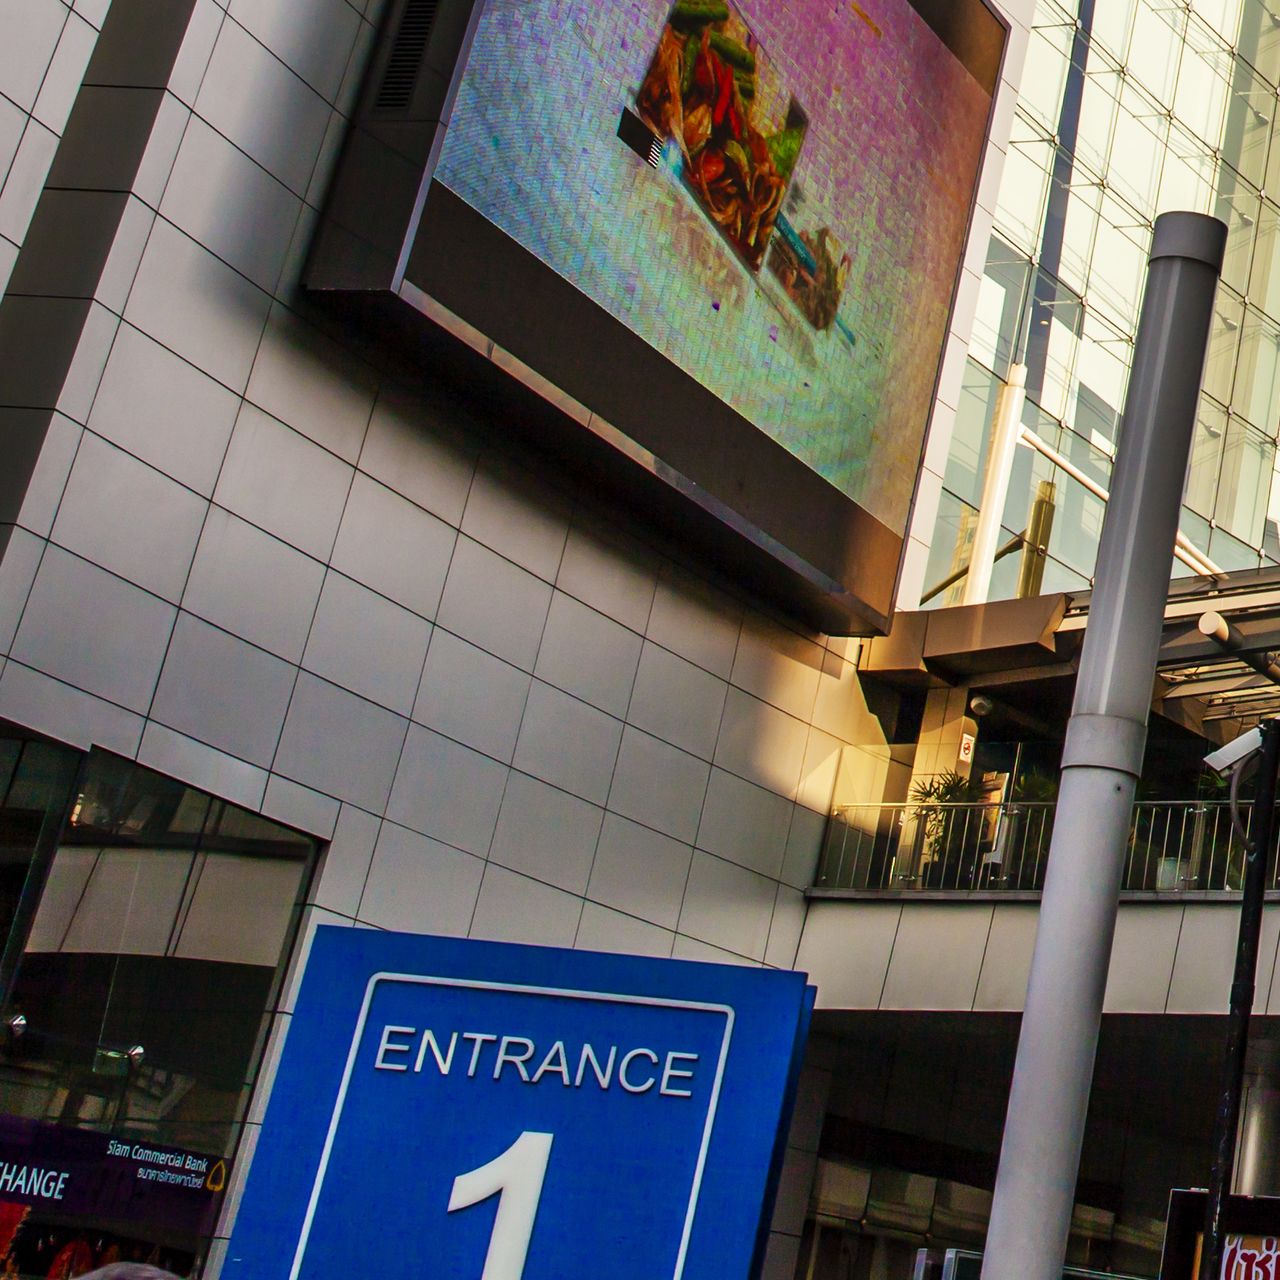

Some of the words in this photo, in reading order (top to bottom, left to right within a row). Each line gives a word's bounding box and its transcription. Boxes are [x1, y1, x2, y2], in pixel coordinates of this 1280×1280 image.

[373, 1024, 699, 1098] ENTRANCE
[0, 1162, 70, 1200] HANGE
[107, 1140, 130, 1159] Siam
[132, 1145, 185, 1167] Commercial
[186, 1157, 209, 1173] Bank
[447, 1130, 555, 1280] 1
